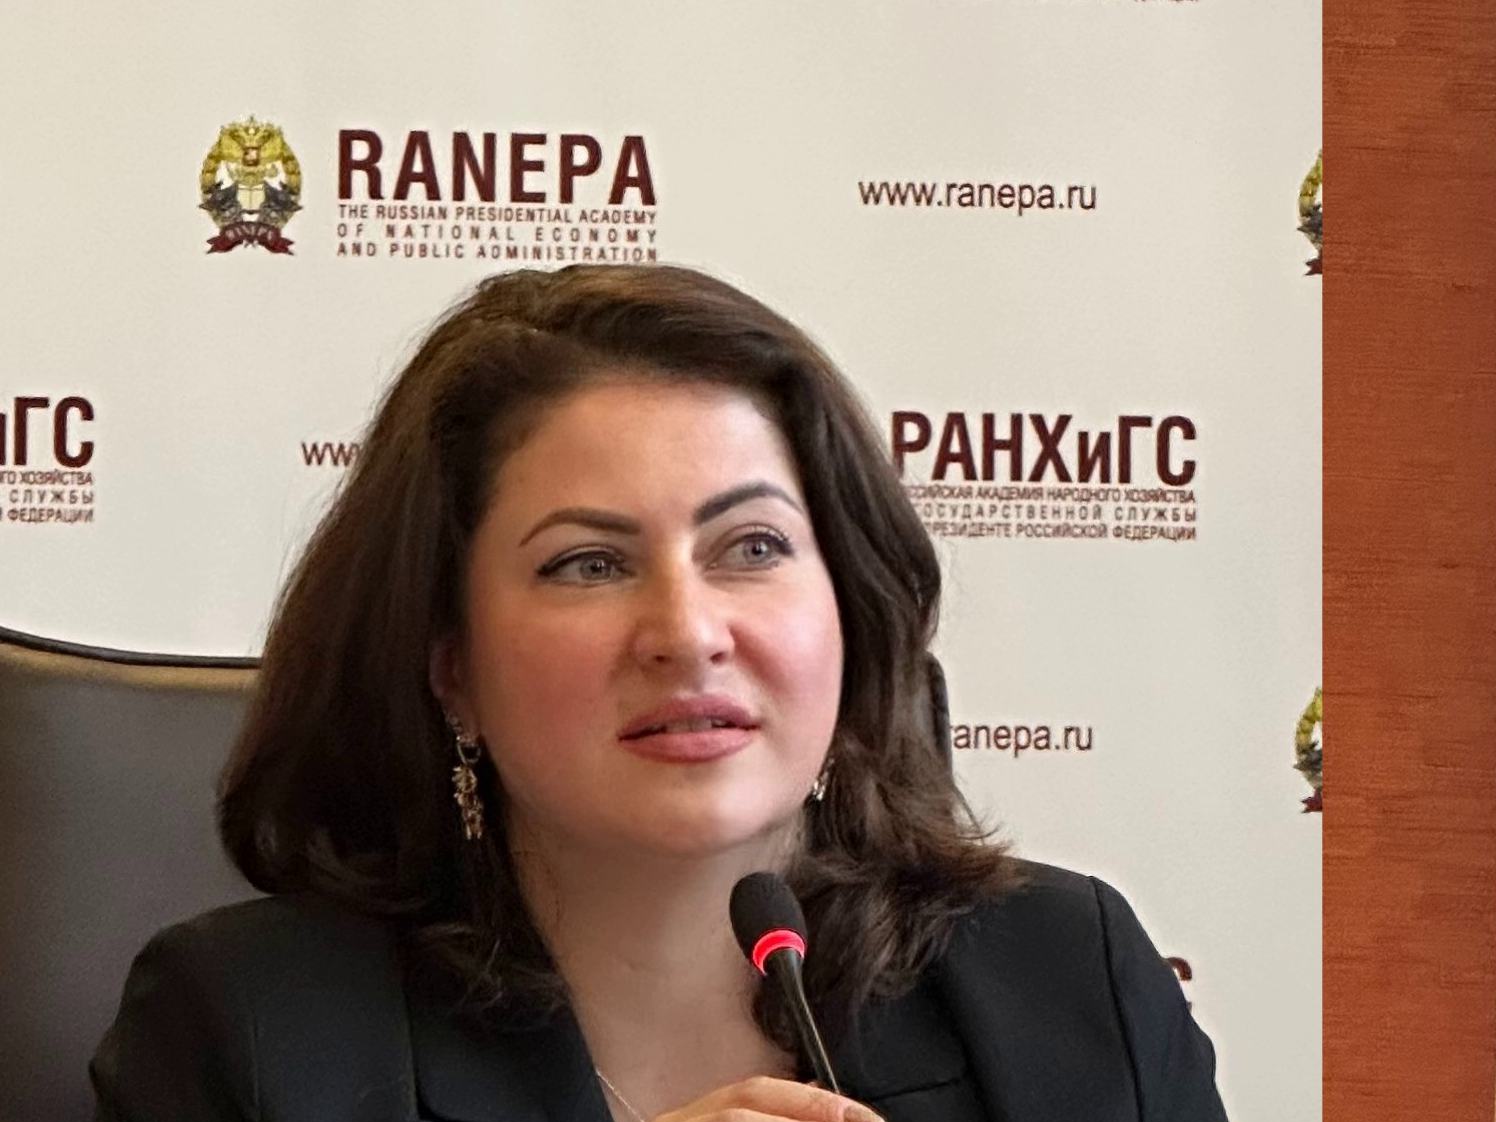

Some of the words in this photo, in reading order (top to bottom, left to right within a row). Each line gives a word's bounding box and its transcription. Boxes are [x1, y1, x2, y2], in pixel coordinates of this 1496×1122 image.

[338, 129, 657, 205] RANEPA
[858, 180, 1097, 216] www.ranepa.ru
[338, 204, 368, 219] THE
[376, 205, 447, 220] RUSSIAN
[455, 206, 571, 222] PRESIDENTIAL
[579, 208, 656, 224] ACADEMY
[337, 223, 363, 238] OF
[385, 224, 515, 240] NATIONAL
[535, 226, 657, 243] ECONOMY
[337, 242, 377, 257] AND
[389, 243, 464, 259] PUBLIC
[476, 244, 657, 262] ADMINISTRATION
[892, 411, 1197, 486] РАНХиГС
[9, 489, 95, 504] СЛУЖБЫ
[975, 485, 1043, 501] АКАДЕМИЯ
[1047, 486, 1120, 502] НАРОДНОГО
[7, 507, 95, 523] ФЕДЕРАЦИИ
[1114, 506, 1196, 522] СЛУЖБЫ
[1112, 525, 1196, 541] ФЕДЕРАЦИИ
